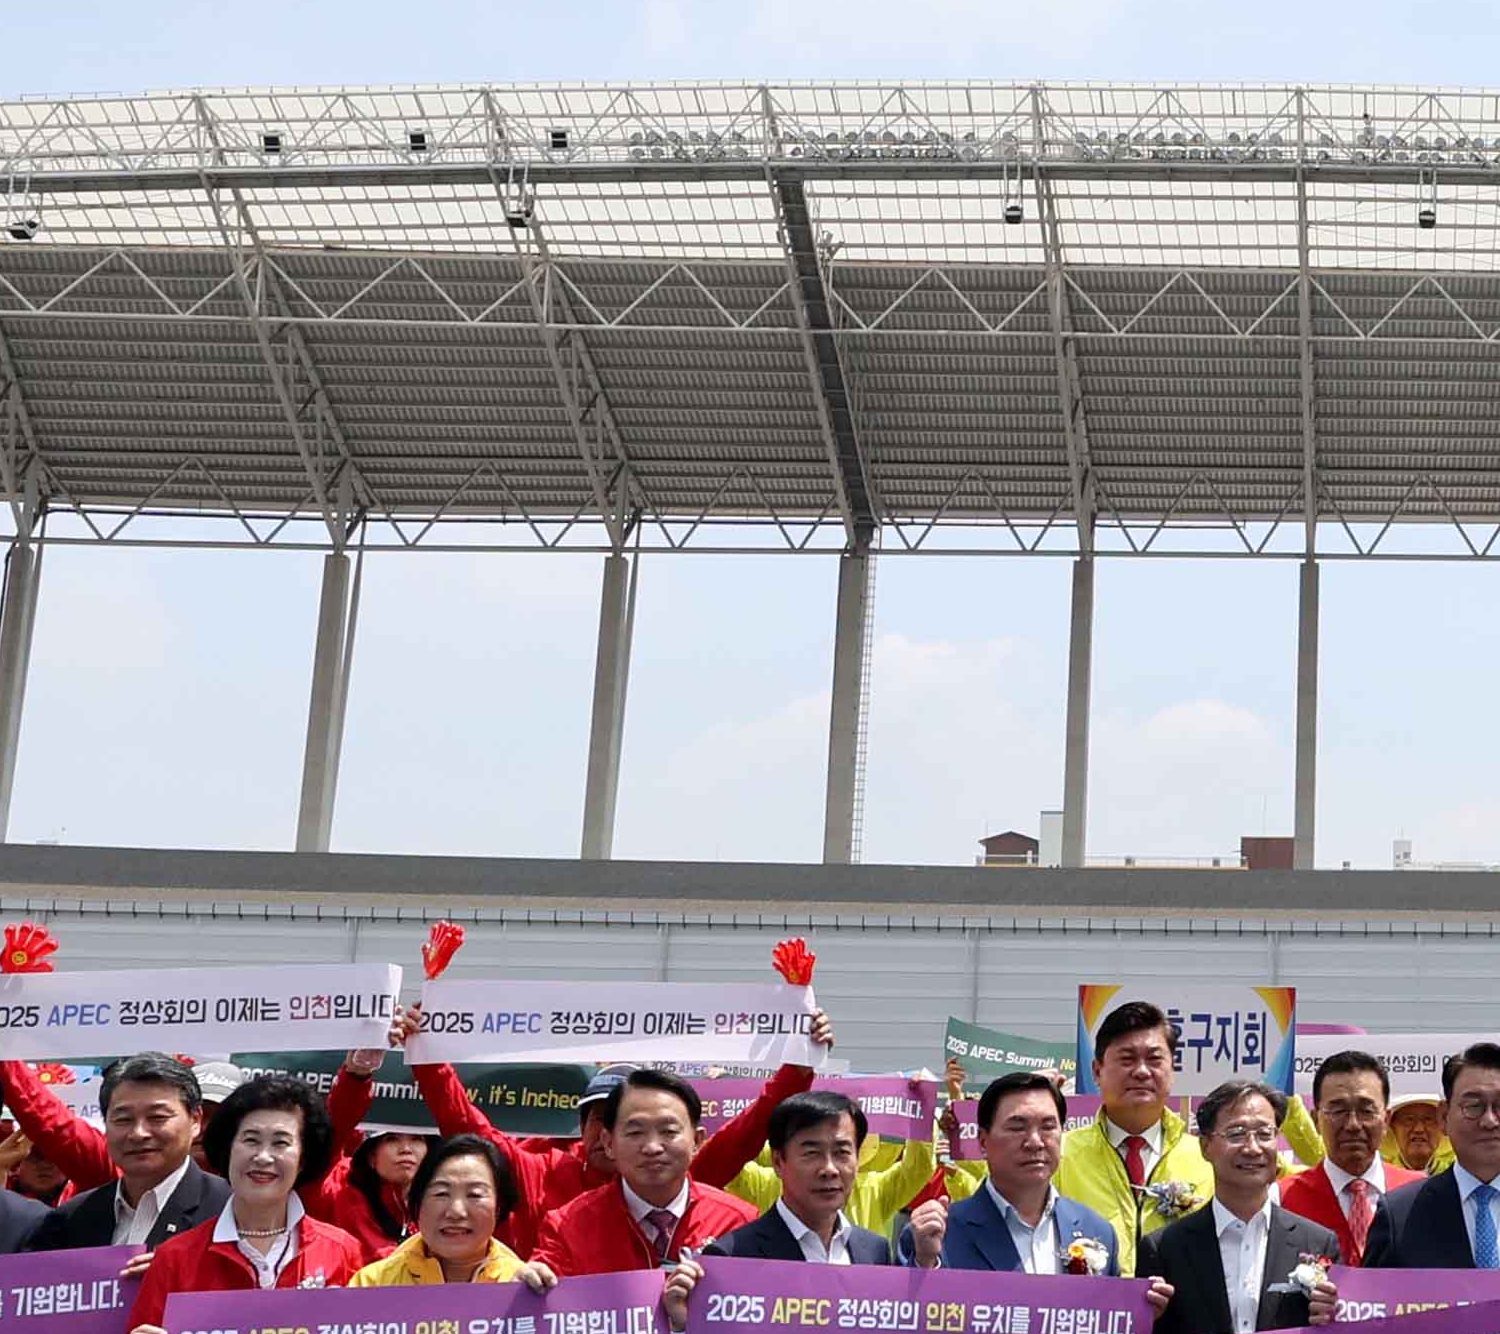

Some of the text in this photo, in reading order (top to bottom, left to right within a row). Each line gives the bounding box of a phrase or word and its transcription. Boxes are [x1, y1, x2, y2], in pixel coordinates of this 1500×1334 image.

[47, 1003, 111, 1027] APEC
[119, 998, 207, 1025] 정상회의
[215, 996, 281, 1023] 이제는
[420, 1010, 706, 1036] 2025 APEC 정상회의 이제는
[946, 1035, 1055, 1069] 2025 APEC Summit
[489, 1084, 516, 1105] it's
[11, 1280, 124, 1316] 기원합니다.
[707, 1294, 764, 1323] 2025
[771, 1298, 831, 1326] APEC
[837, 1298, 919, 1331] 정상회의
[926, 1302, 965, 1333] 인천
[971, 1305, 1031, 1334] 유치를
